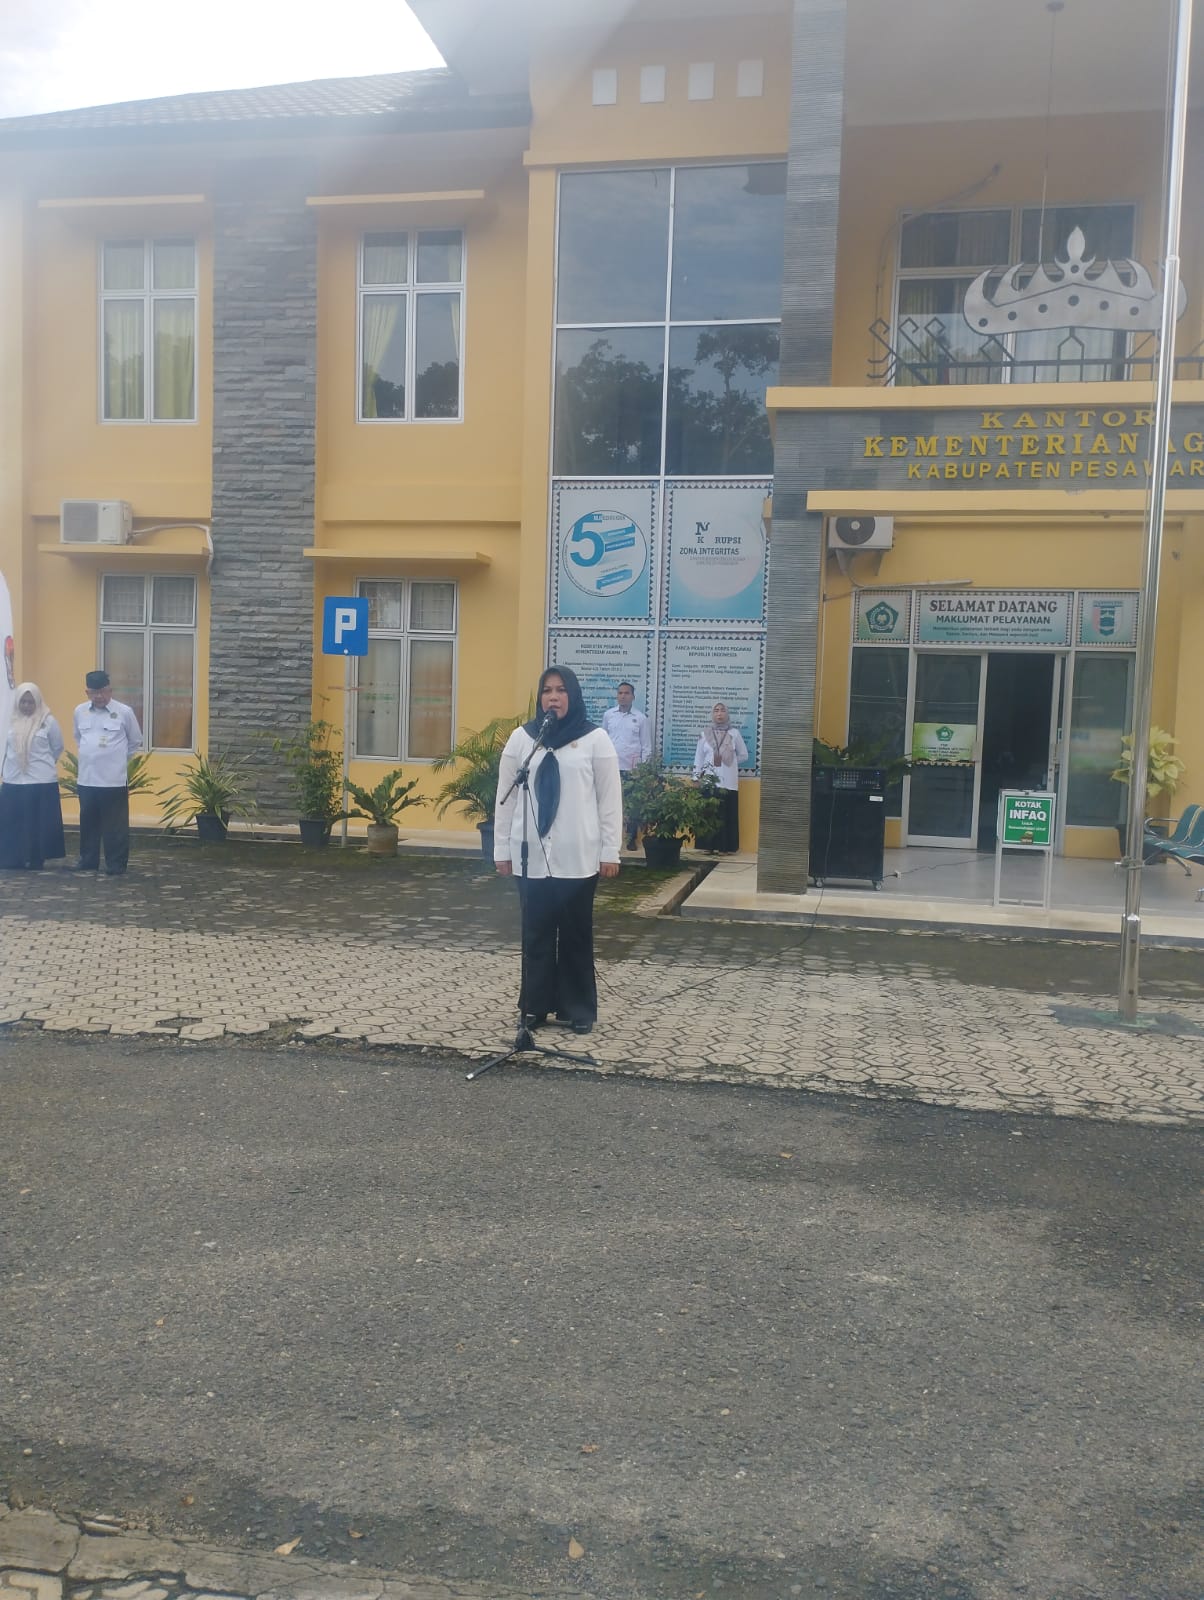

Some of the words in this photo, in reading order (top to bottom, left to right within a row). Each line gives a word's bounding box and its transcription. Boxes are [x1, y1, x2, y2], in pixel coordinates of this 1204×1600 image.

[980, 408, 1157, 429] KANTOR
[863, 432, 1139, 457] KEMENTERIAN
[1167, 431, 1204, 454] G
[907, 460, 1061, 480] KABUPATEN
[679, 547, 698, 555] ZONA
[699, 547, 740, 556] INTEGRITAS
[929, 599, 995, 613] SELAMAT
[998, 600, 1058, 614] DATANG
[334, 607, 357, 644] P
[936, 615, 990, 624] MAKLUMAT
[992, 615, 1051, 625] PELAYANAN
[1014, 800, 1042, 809] KOTAK
[1009, 809, 1047, 822] INFAQ
